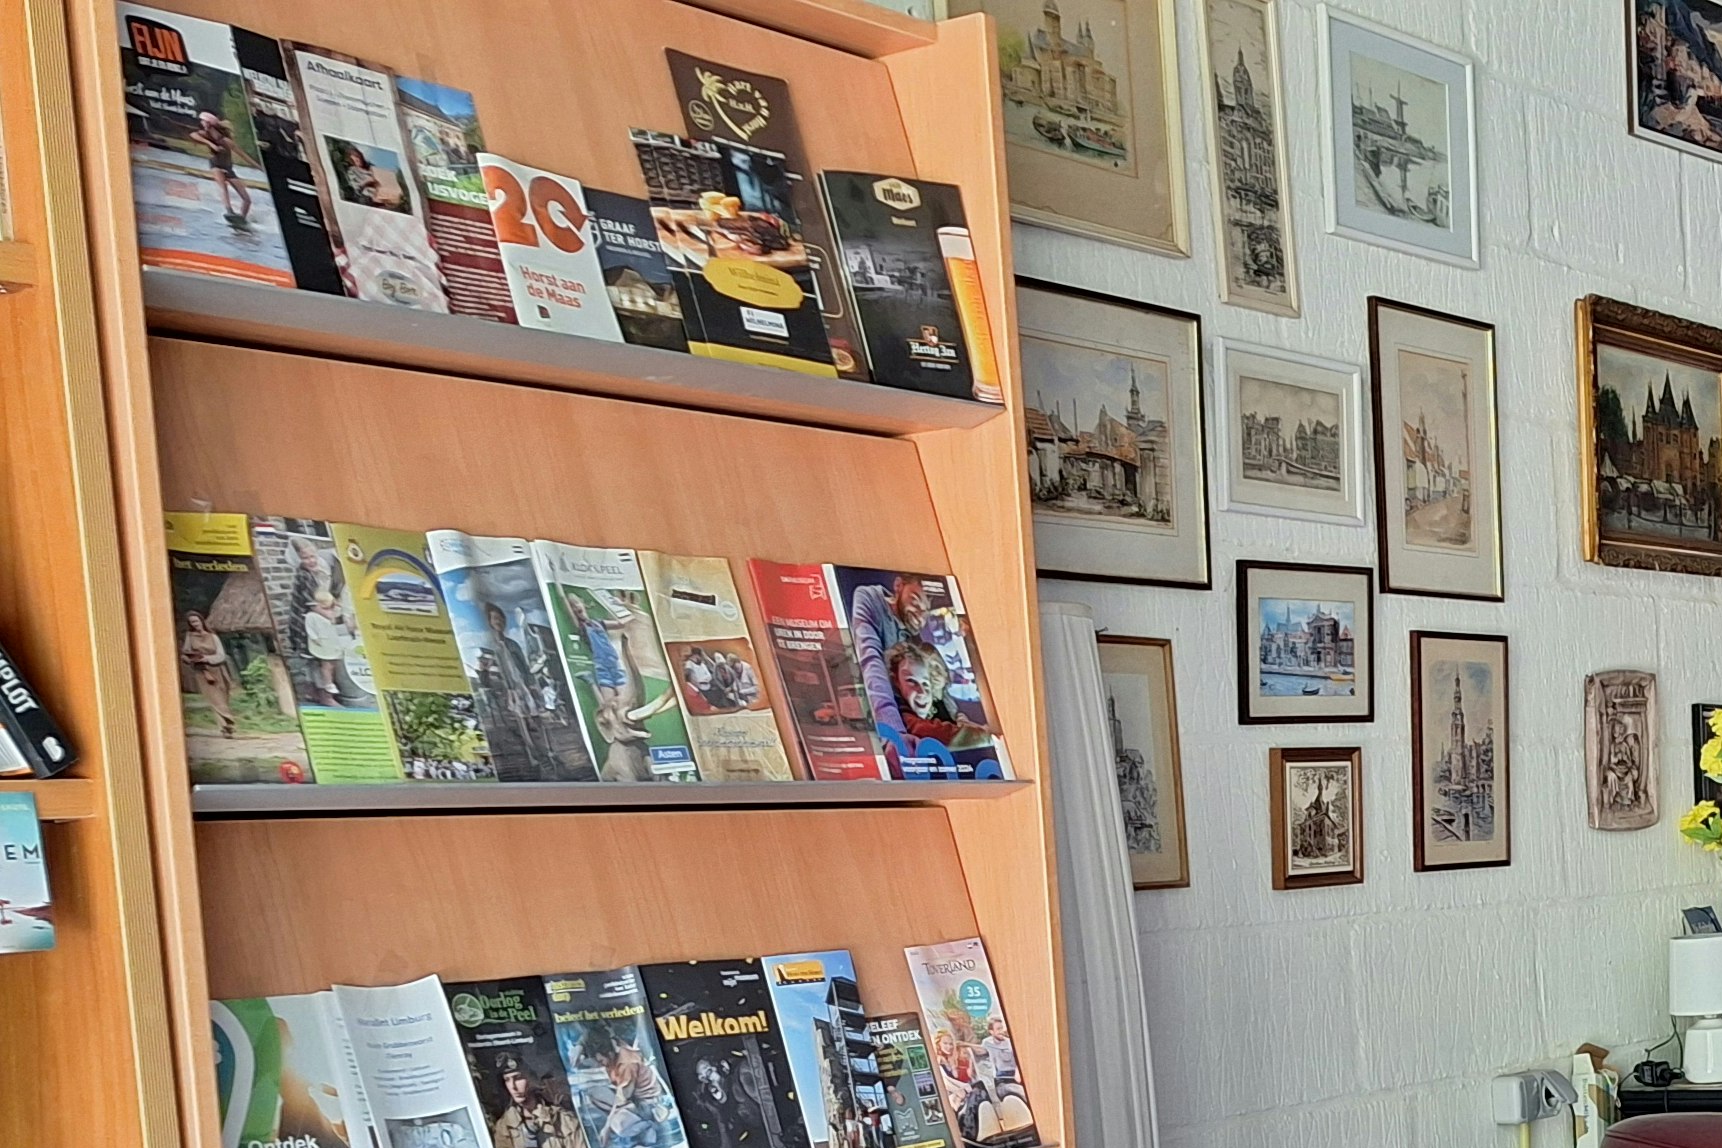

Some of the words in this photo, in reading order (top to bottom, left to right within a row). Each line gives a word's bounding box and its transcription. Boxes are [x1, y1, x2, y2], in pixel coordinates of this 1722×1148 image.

[306, 60, 384, 90] Afhaalkaart
[427, 182, 490, 205] IJSVOGE
[600, 218, 637, 236] GRAAF
[604, 232, 627, 246] TER
[628, 233, 663, 253] HORST
[519, 265, 558, 286] Horst
[561, 277, 586, 295] aan
[527, 283, 546, 299] de
[546, 286, 582, 309] Maas
[966, 985, 981, 998] 35
[508, 1005, 537, 1022] Peel
[655, 1009, 770, 1041] Welkom!
[881, 1029, 922, 1043] ONTDEK
